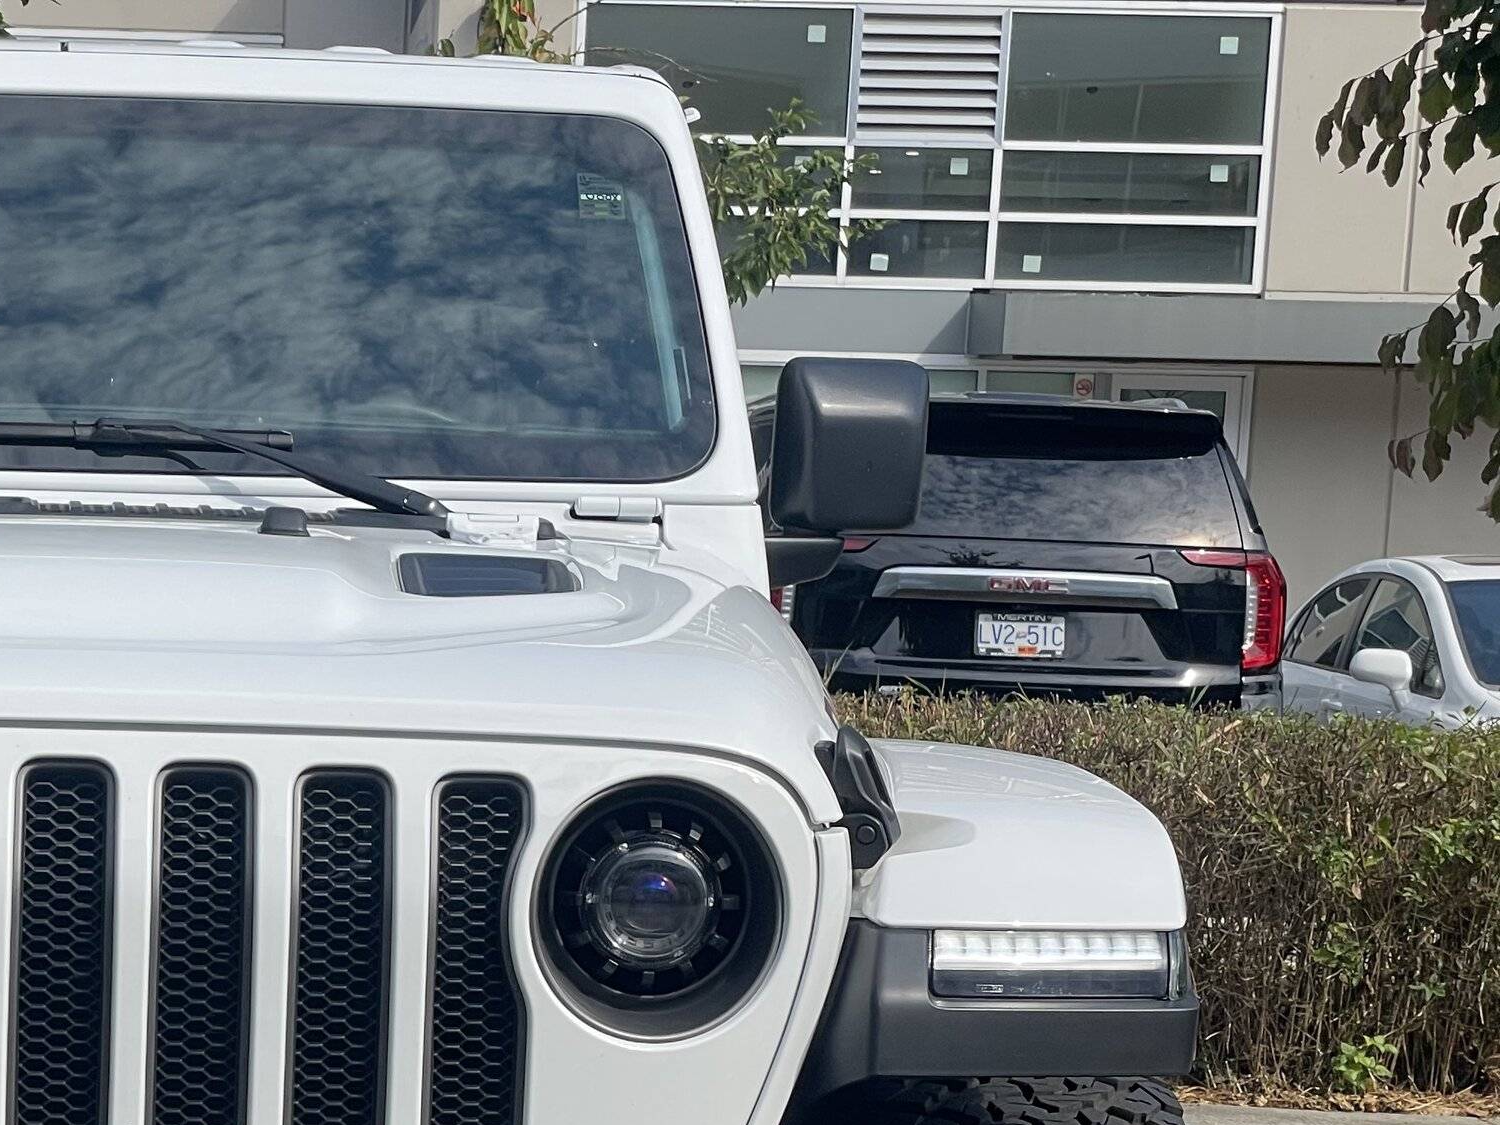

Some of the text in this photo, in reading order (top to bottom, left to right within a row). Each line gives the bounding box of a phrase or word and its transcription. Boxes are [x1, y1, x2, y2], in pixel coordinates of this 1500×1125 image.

[989, 577, 1069, 593] GMC
[979, 623, 1063, 647] LV2 51C
